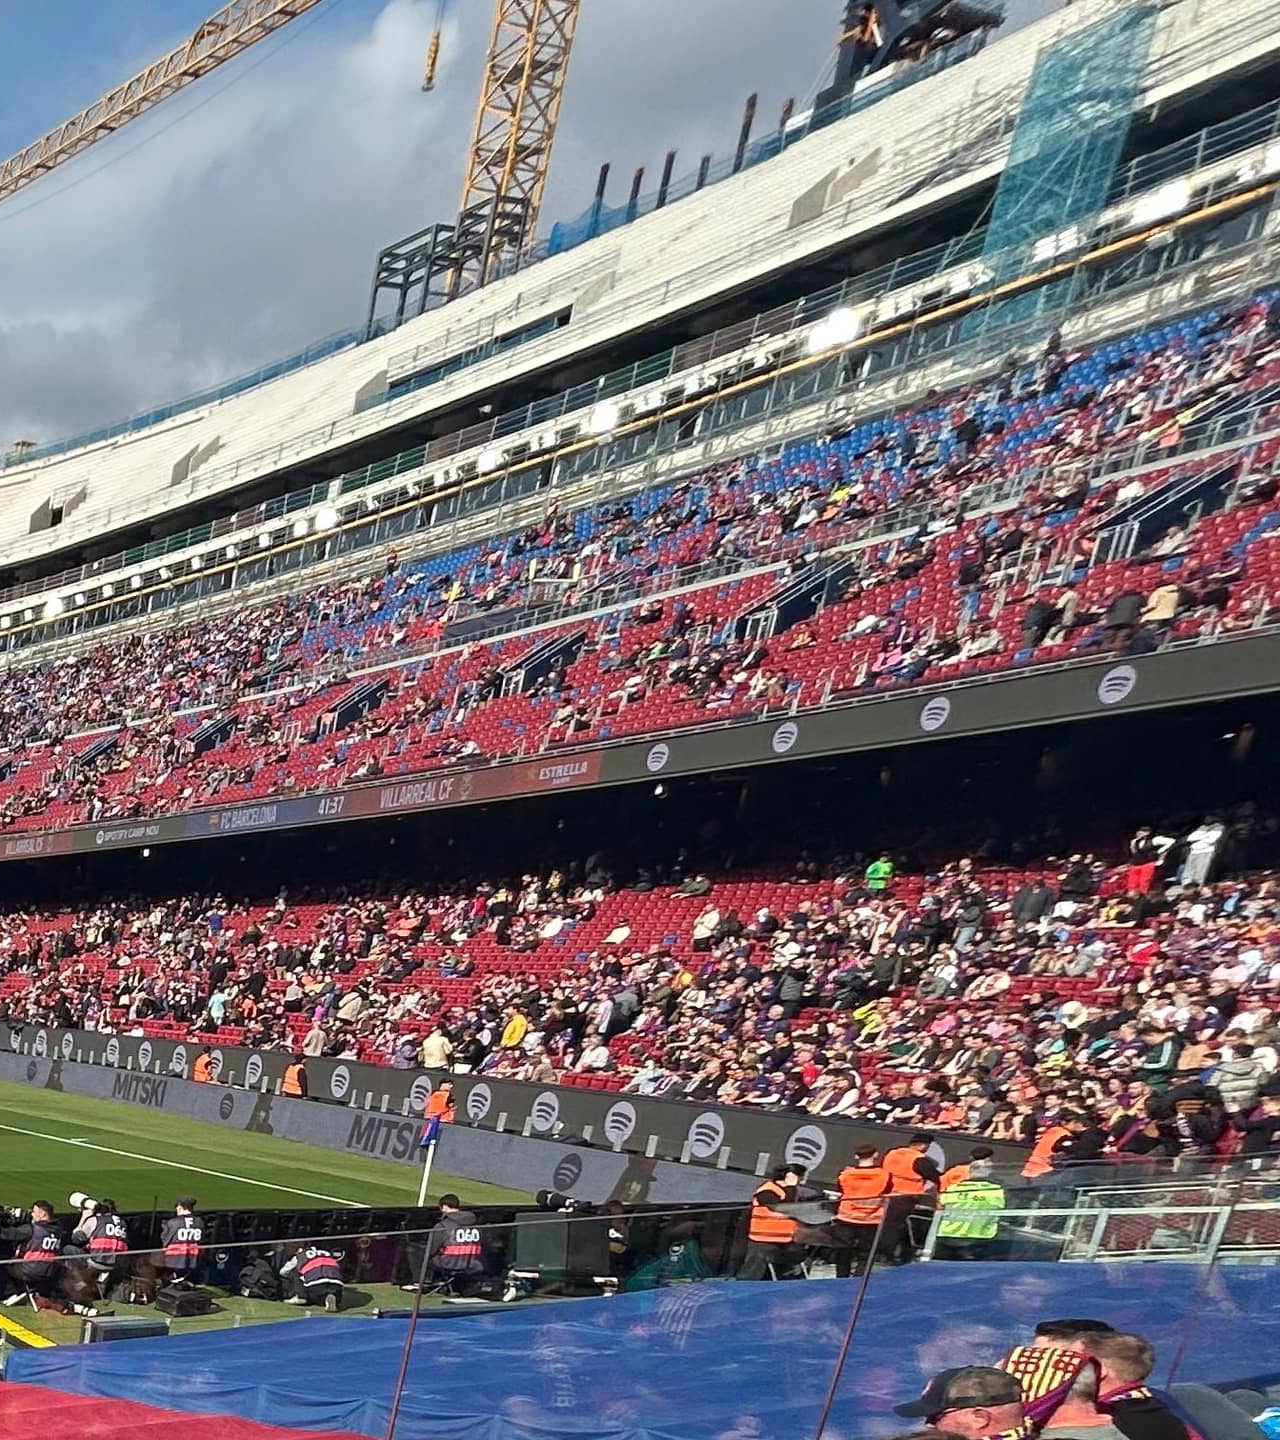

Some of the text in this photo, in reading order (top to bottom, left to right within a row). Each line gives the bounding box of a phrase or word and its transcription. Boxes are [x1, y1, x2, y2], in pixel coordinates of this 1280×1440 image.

[539, 761, 588, 780] ESTRELLA
[220, 778, 454, 830] FC BARCELONA 41:37 VILLARREAL CF
[112, 1072, 167, 1108] MITSKI
[177, 1228, 202, 1241] 078
